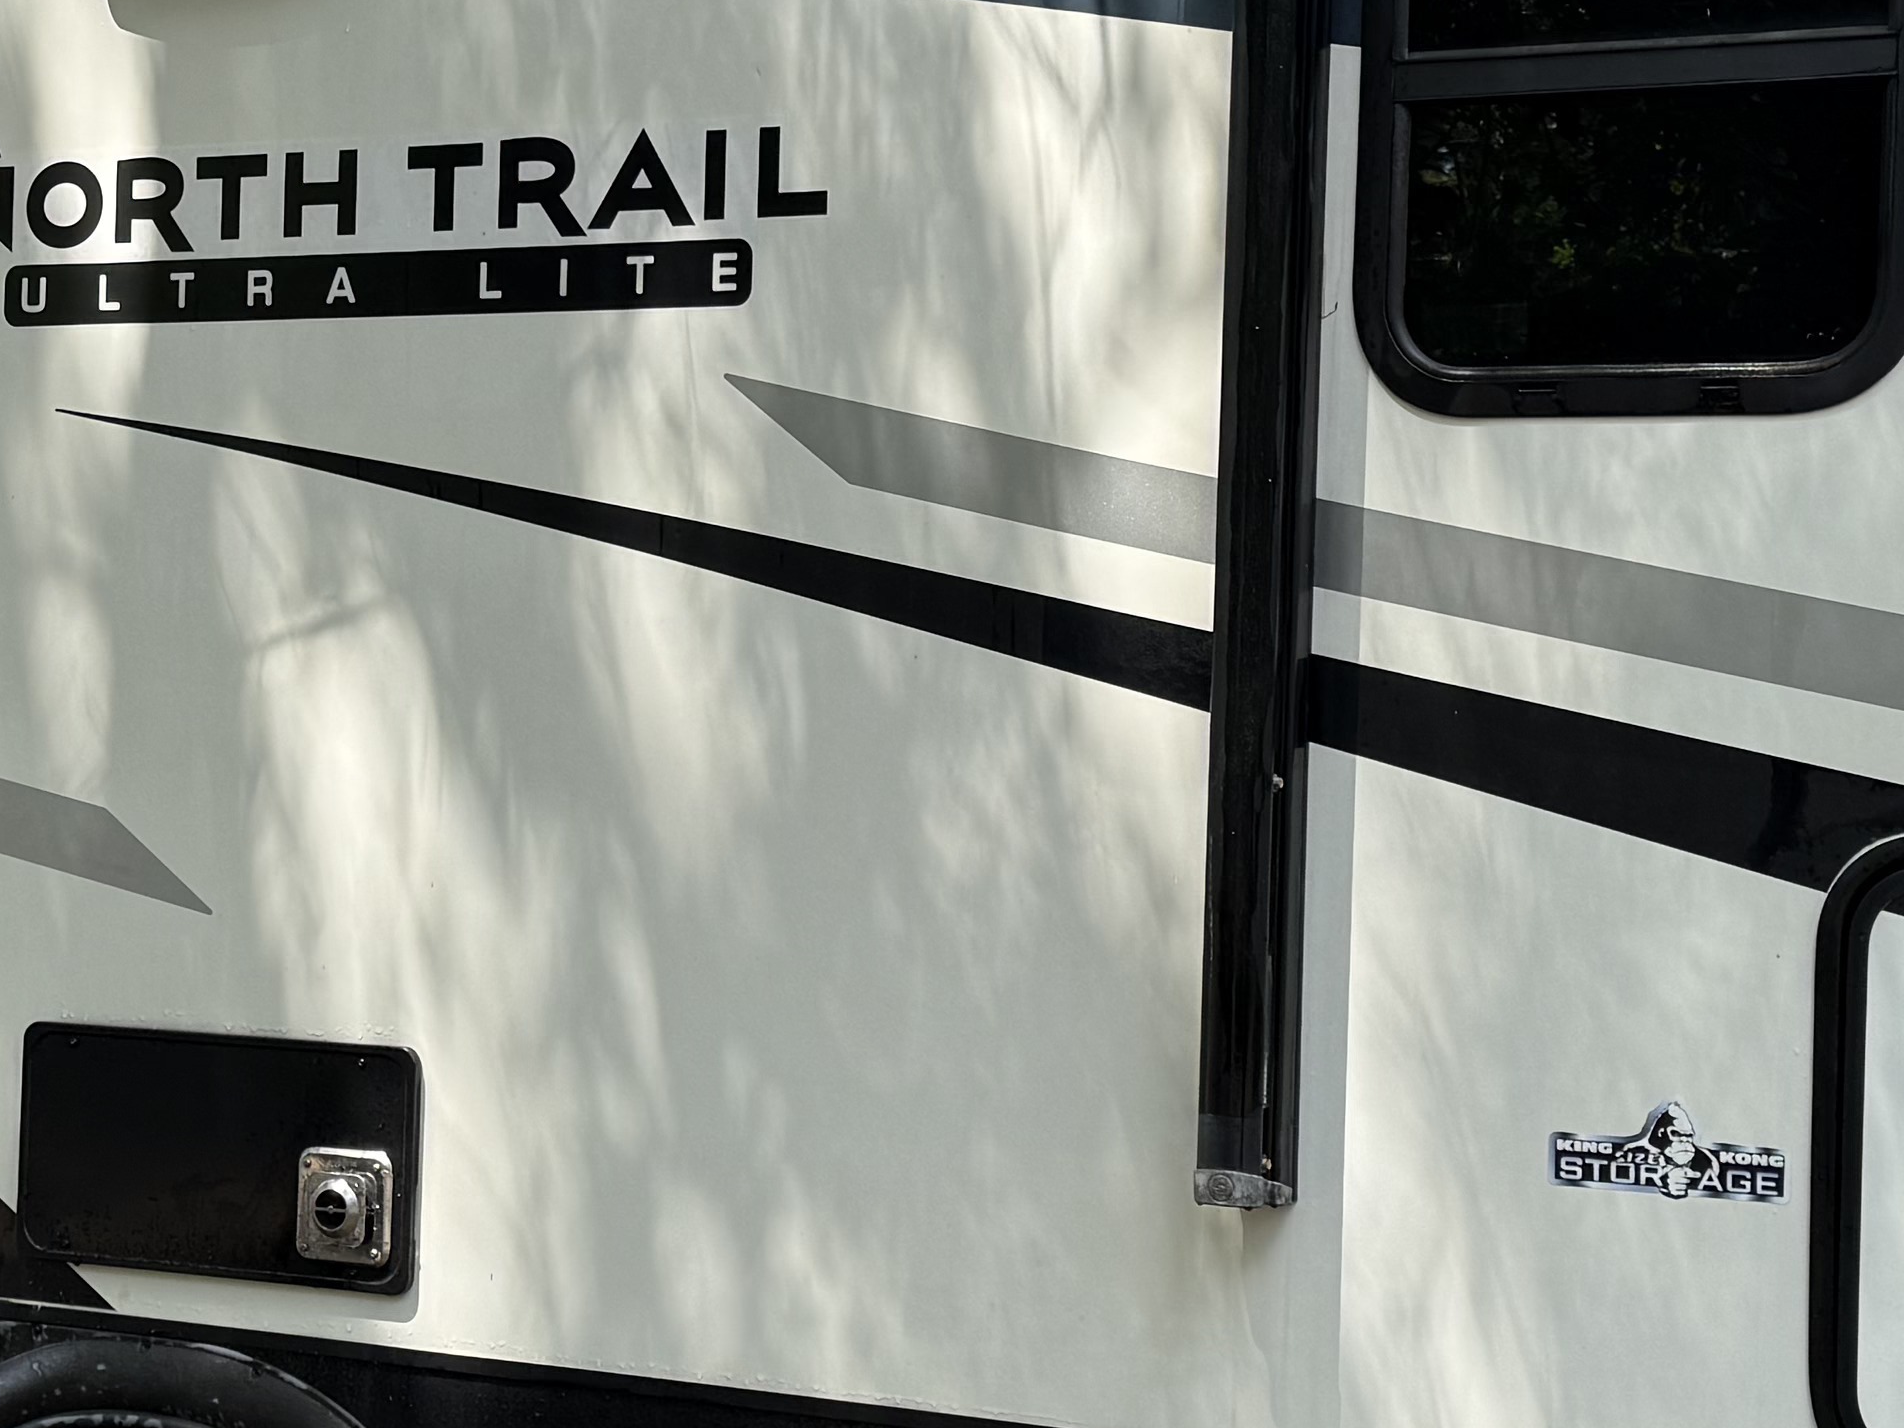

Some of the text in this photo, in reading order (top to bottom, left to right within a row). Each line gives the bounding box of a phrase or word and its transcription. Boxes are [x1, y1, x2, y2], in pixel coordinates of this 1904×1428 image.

[407, 126, 829, 237] TRAIL
[20, 251, 739, 314] ULTRA LITE
[1556, 1138, 1785, 1168] KING KONG
[1559, 1156, 1780, 1195] STORAGE
